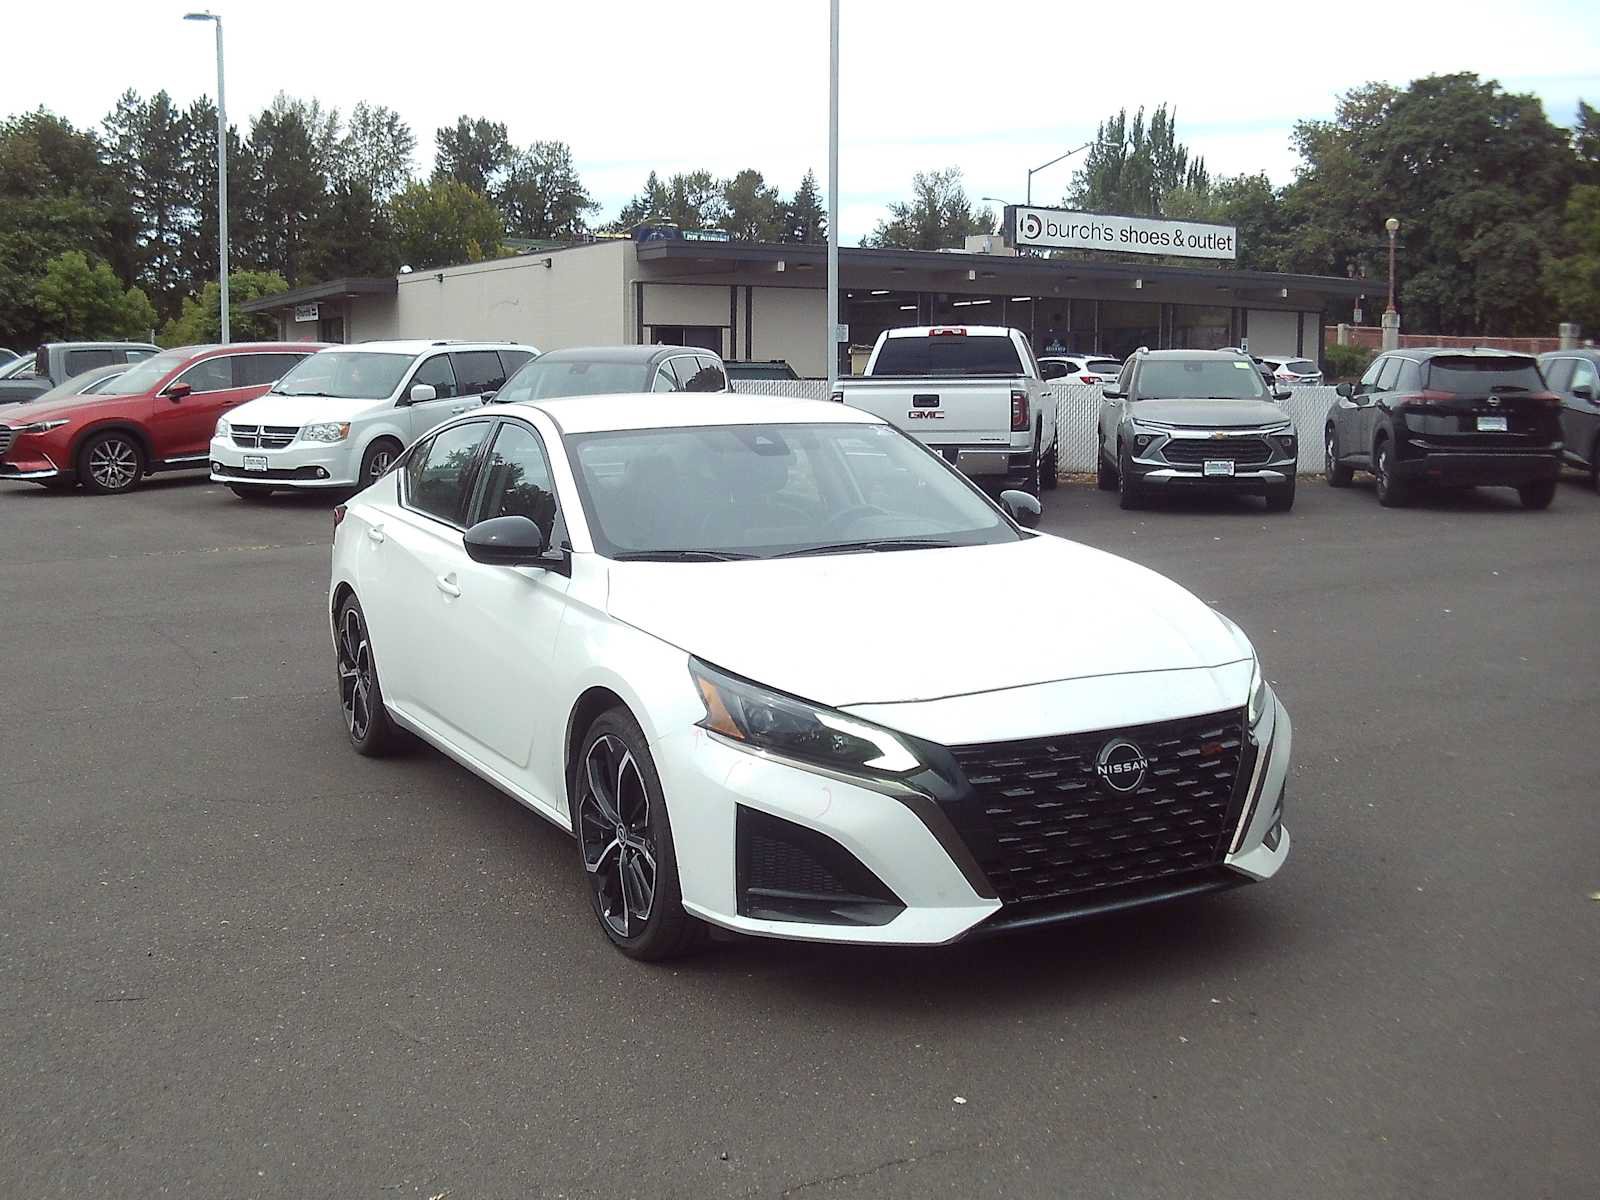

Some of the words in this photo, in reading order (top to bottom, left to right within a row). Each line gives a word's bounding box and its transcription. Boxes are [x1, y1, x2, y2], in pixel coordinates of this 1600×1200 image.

[1047, 218, 1114, 241] burch's
[1119, 226, 1170, 245] shoes
[1173, 229, 1185, 247] &
[1187, 233, 1233, 251] outlet
[908, 410, 945, 419] GMC
[1097, 759, 1149, 775] NISSAN
